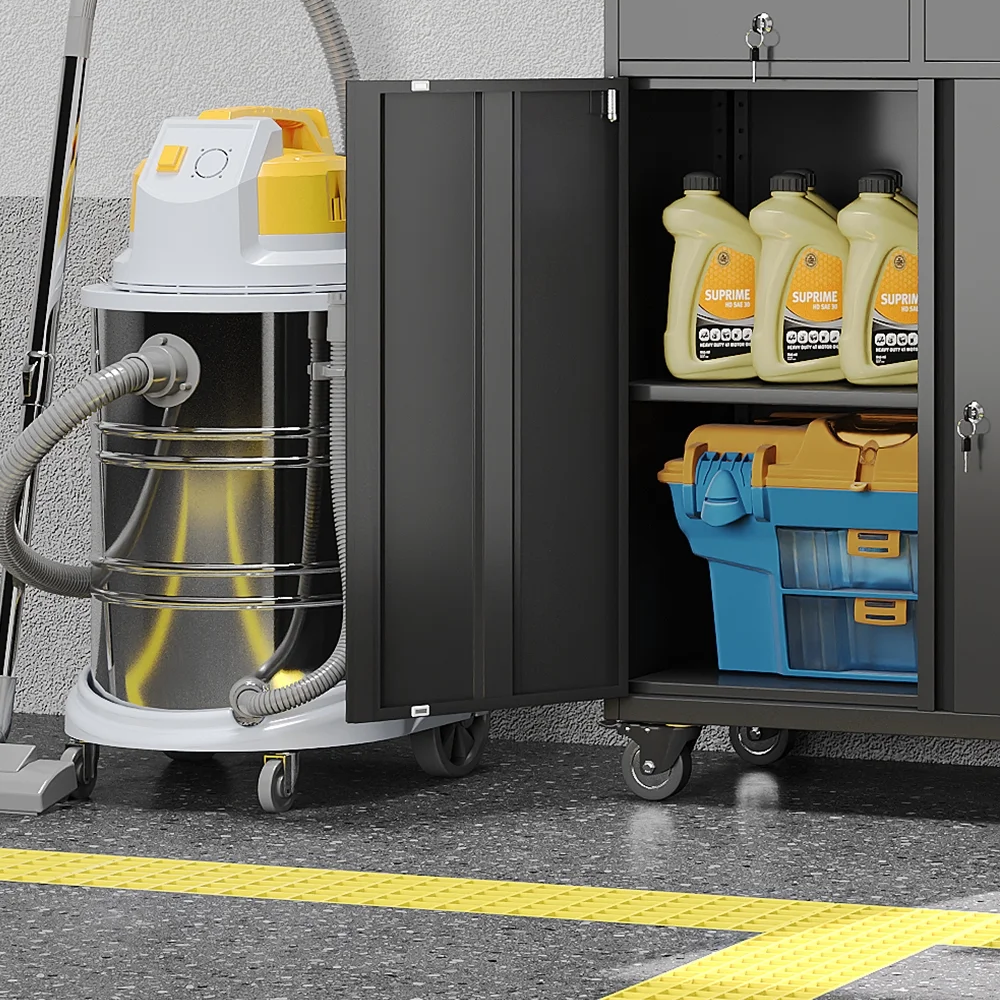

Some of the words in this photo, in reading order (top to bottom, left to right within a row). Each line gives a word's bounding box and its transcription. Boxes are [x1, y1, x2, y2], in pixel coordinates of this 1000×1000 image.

[704, 289, 751, 301] SUPRIME
[792, 291, 838, 303] SUPRIME
[880, 293, 918, 305] SUPRIM
